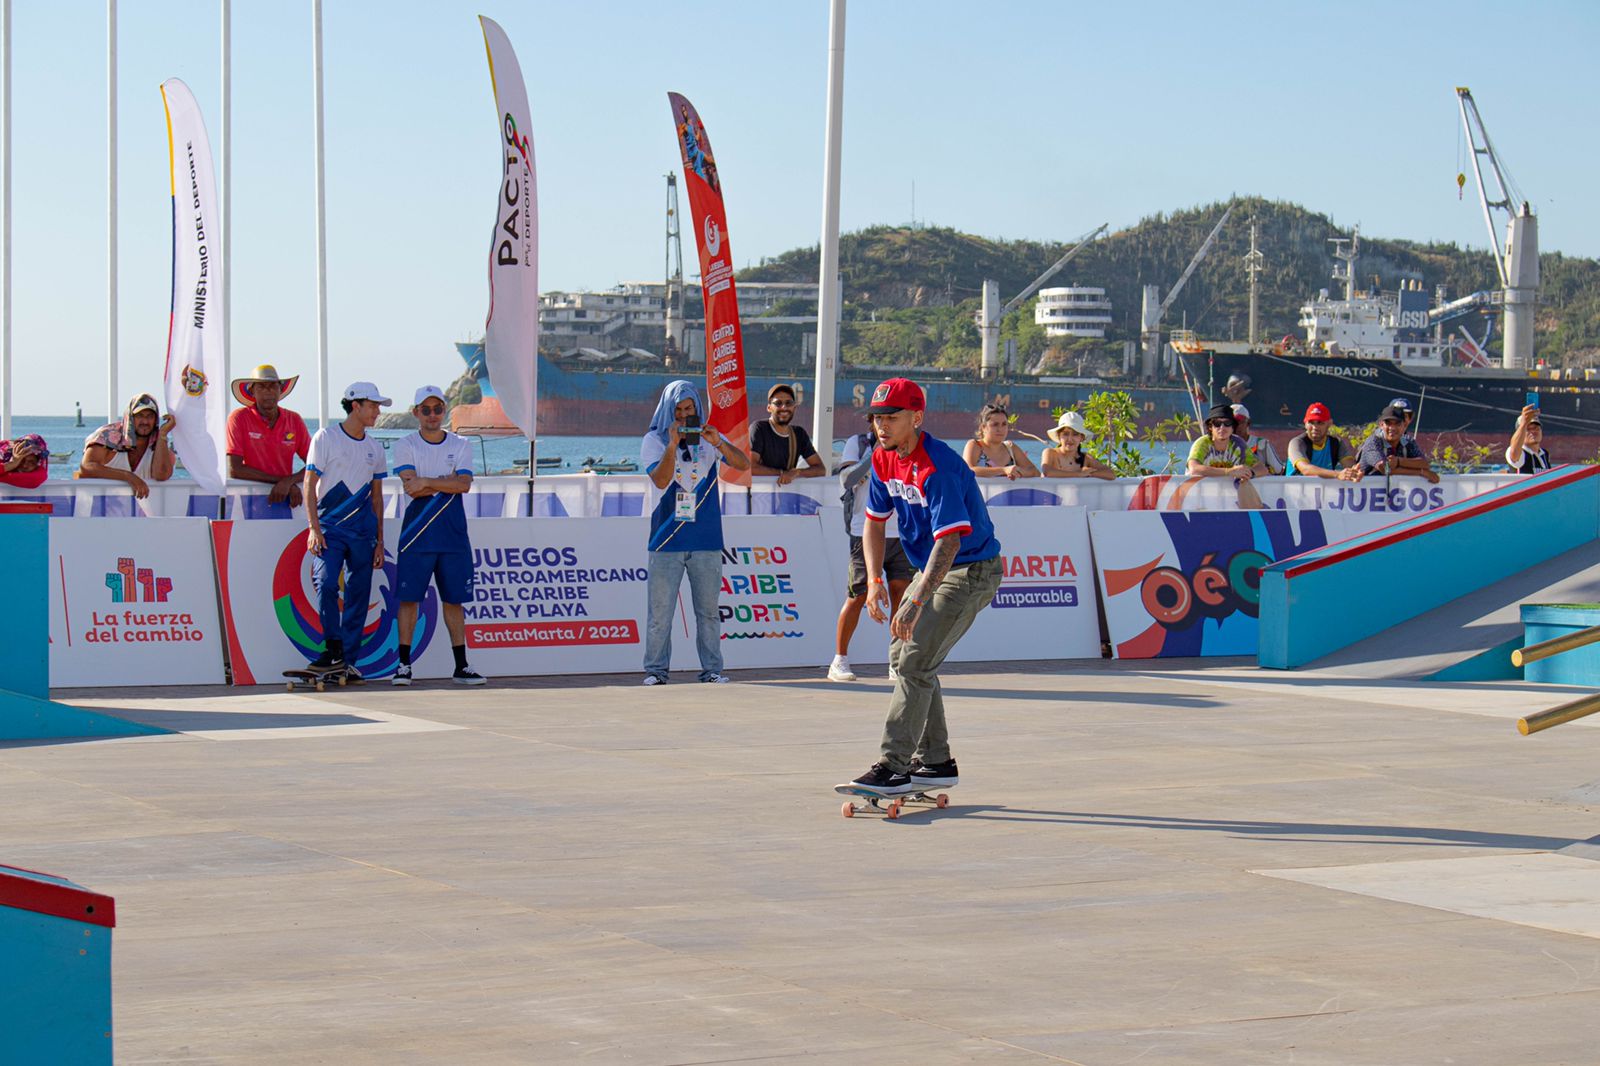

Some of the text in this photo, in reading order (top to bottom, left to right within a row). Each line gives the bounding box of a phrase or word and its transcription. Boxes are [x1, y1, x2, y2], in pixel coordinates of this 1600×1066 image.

[498, 112, 520, 266] PACTO
[524, 168, 532, 239] DEPORTE
[187, 140, 208, 330] MINISTERIO DEL DEPORTE
[712, 323, 735, 344] CENTRO
[712, 340, 737, 362] CARIBE
[712, 358, 738, 380] SPORTS
[1308, 364, 1379, 378] PREDATOR
[1329, 486, 1445, 513] JUEGOS
[473, 546, 578, 568] JUEGOS
[720, 546, 788, 565] NTRO
[1001, 554, 1078, 577] ARTA
[473, 567, 649, 585] ENTROAMERICANO
[720, 574, 794, 595] ARIBE
[475, 585, 590, 602] DEL CARIBE
[994, 589, 1073, 607] imparable
[92, 610, 194, 626] La fuerza
[463, 602, 589, 619] MAR Y PLAYA
[718, 603, 800, 623] PORTS
[85, 626, 204, 643] del cambio
[472, 627, 575, 643] SantaMarta
[588, 625, 631, 640] 2022
